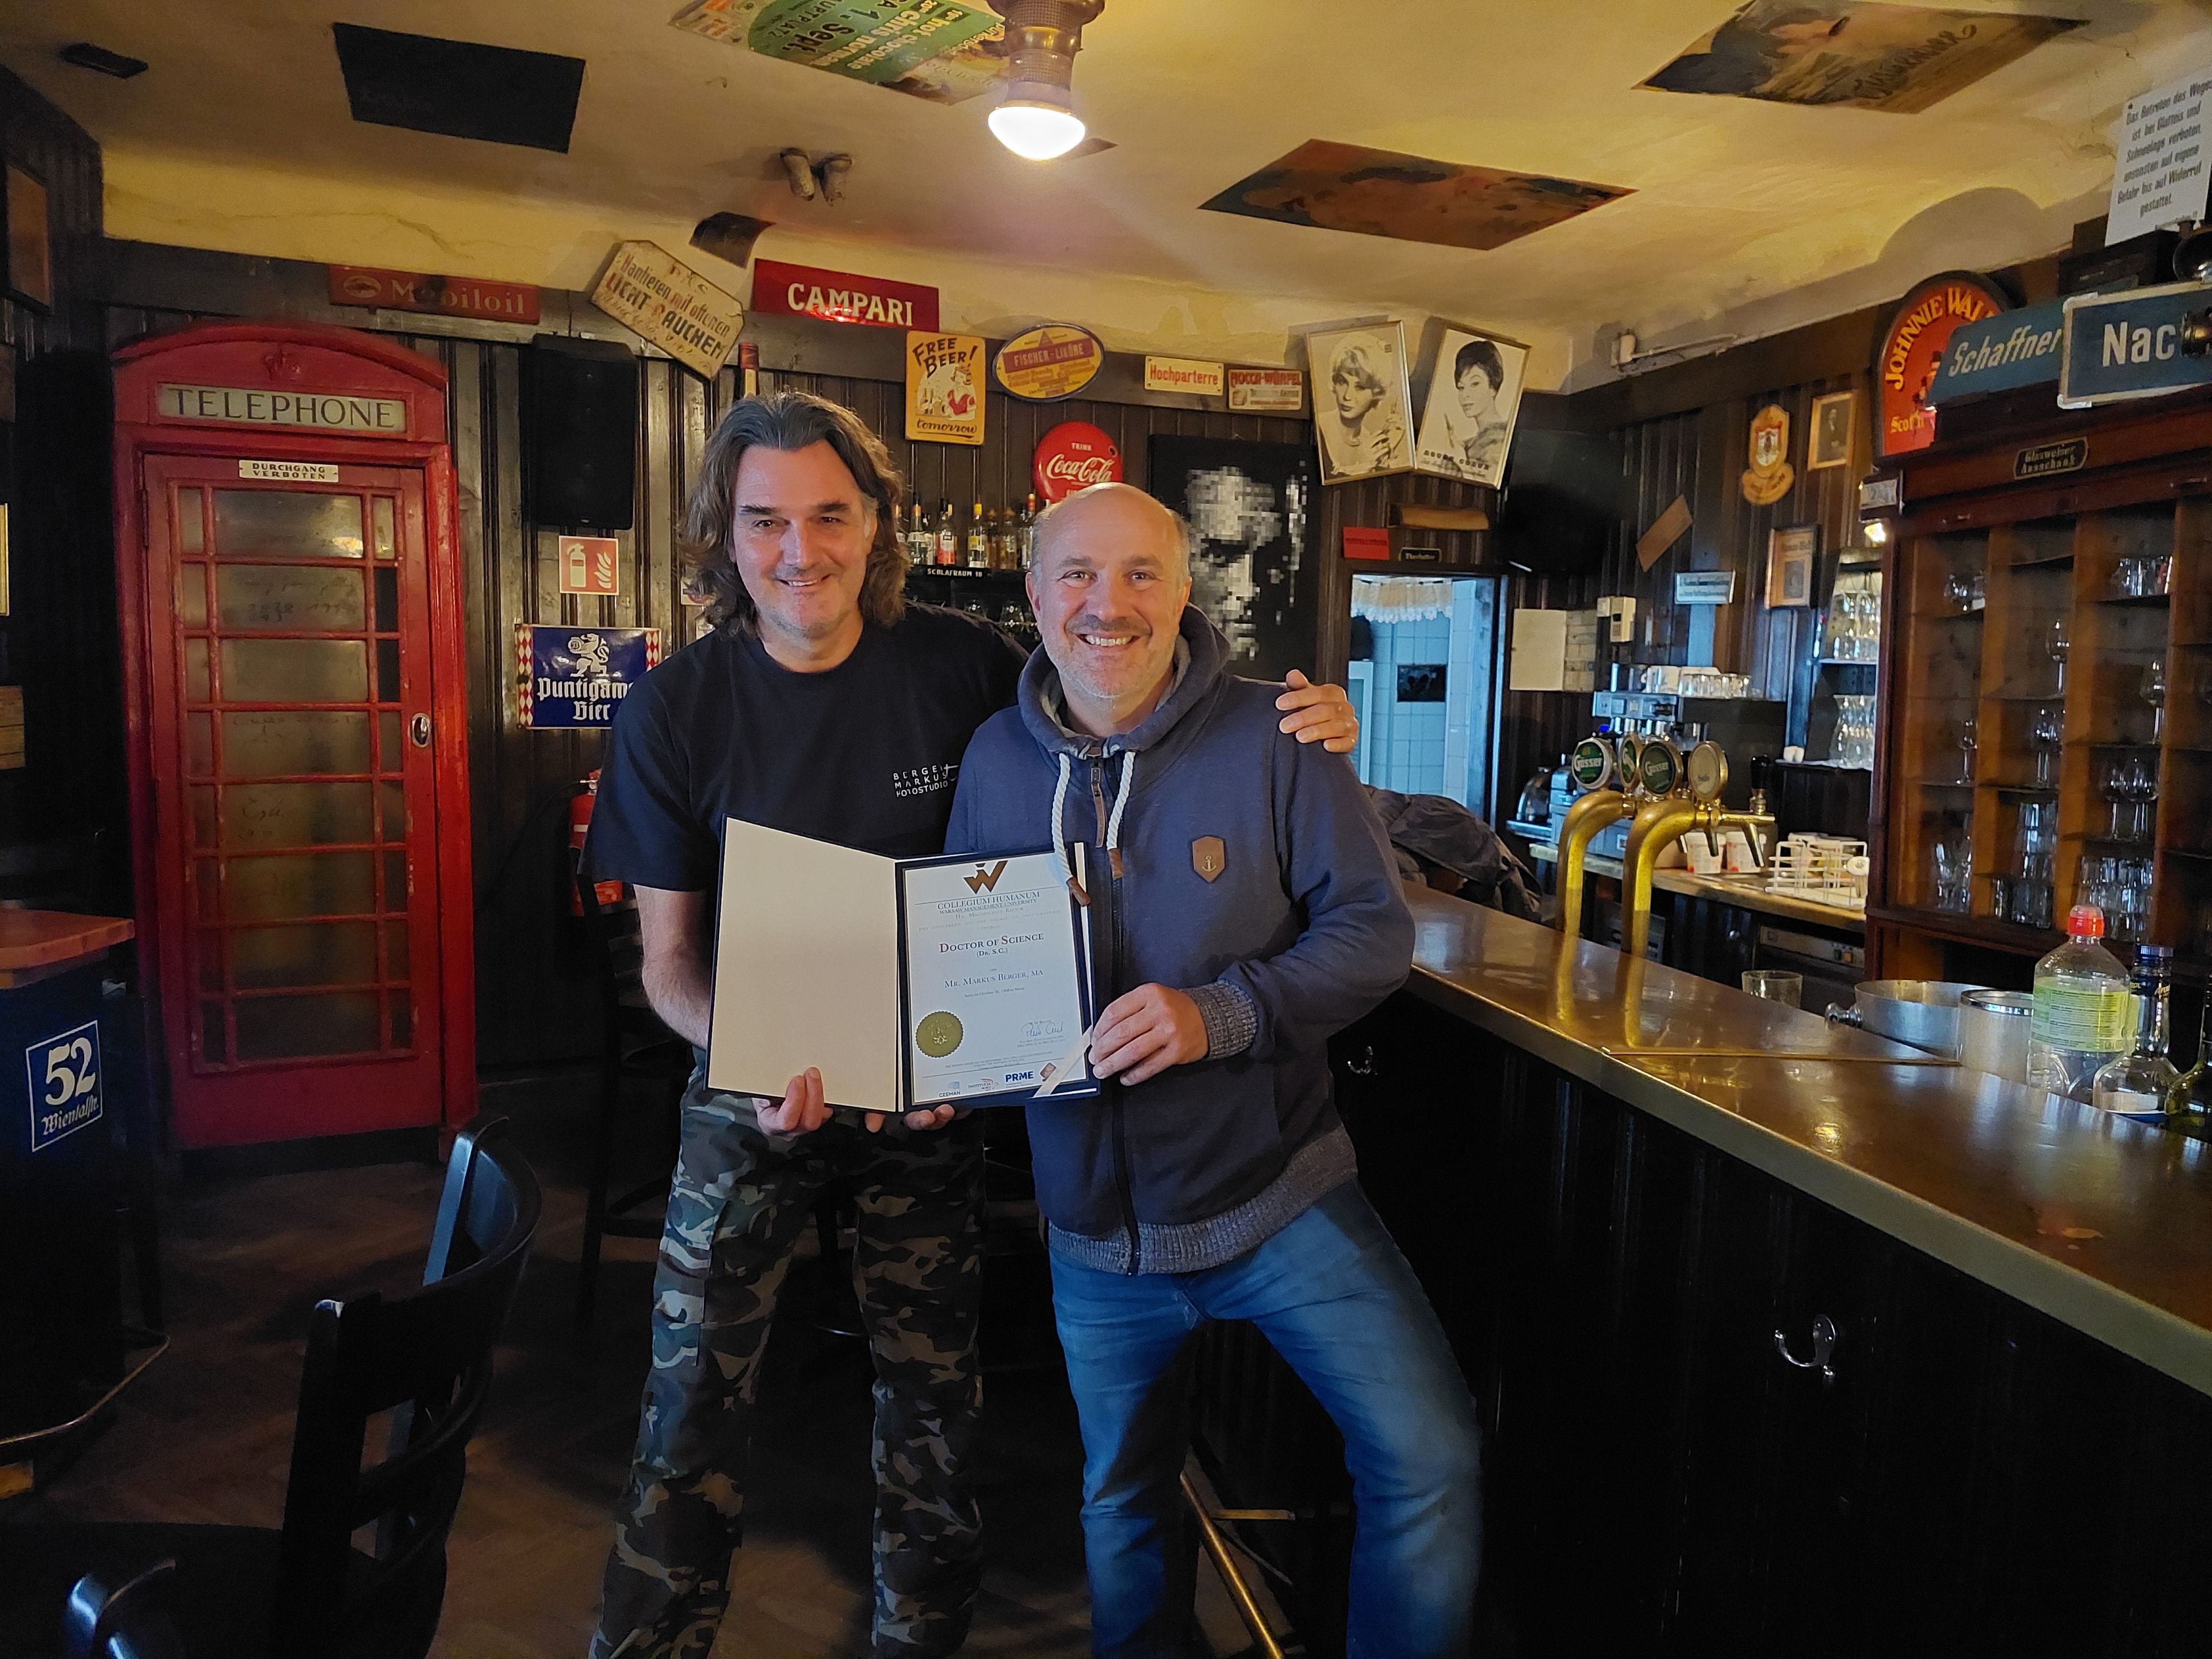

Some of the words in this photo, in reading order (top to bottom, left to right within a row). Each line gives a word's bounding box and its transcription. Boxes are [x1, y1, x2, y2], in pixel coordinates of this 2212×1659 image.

[782, 23, 855, 53] Sept.
[2126, 112, 2138, 125] Das
[2132, 128, 2141, 142] ist
[2145, 120, 2155, 135] bei
[2187, 100, 2201, 118] und
[620, 254, 671, 299] Hantieren
[787, 283, 912, 326] CAMPARI
[1885, 295, 1943, 390] JOHNNIE
[1947, 288, 1995, 321] WAL
[912, 337, 957, 366] FREE
[924, 345, 978, 378] BEER!
[1150, 364, 1218, 385] Hochparterre
[167, 388, 394, 429] TELEPHONE
[917, 418, 977, 434] tomorrow
[1071, 442, 1092, 451] TRINK
[252, 462, 326, 474] DURCHGANG
[253, 470, 326, 480] VERBOTEN
[927, 568, 972, 577] SCHLAFRAUM
[536, 677, 634, 701] Puntigam
[572, 700, 611, 721] Bier
[893, 765, 943, 780] BERGE
[895, 772, 946, 789] MARKUS
[937, 894, 990, 910] COLLEGIUM
[993, 891, 1040, 904] HUMANUM
[1003, 899, 1037, 909] UNIVERSITY
[1031, 969, 1044, 977] MA
[45, 1037, 96, 1105] 52
